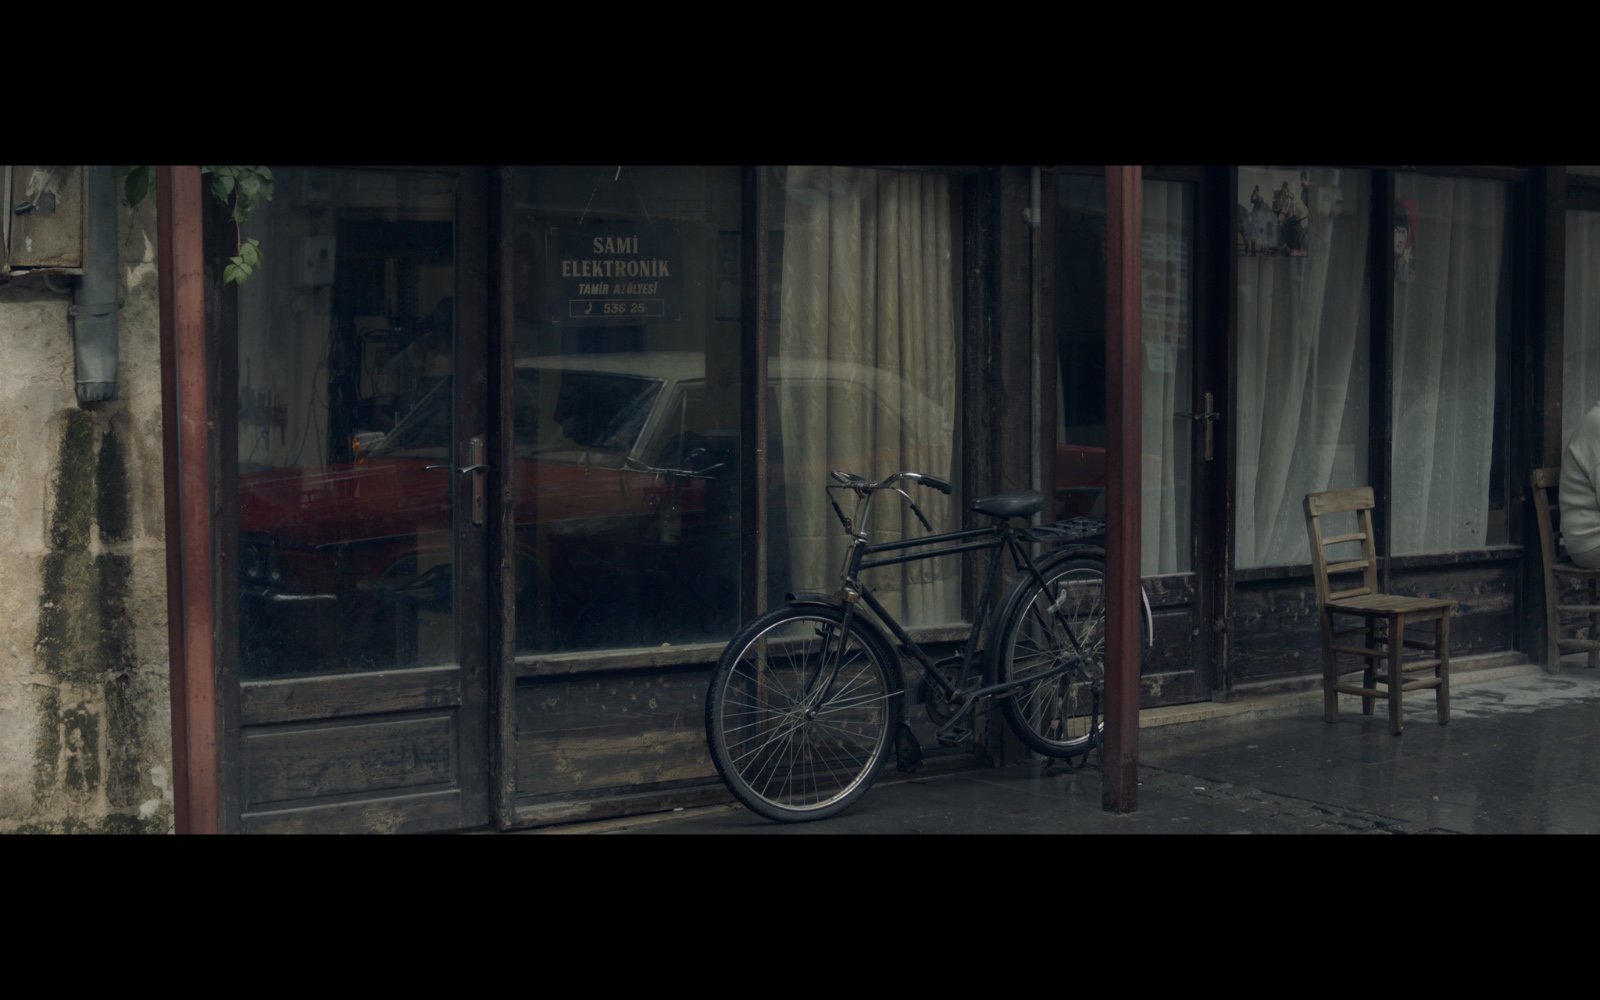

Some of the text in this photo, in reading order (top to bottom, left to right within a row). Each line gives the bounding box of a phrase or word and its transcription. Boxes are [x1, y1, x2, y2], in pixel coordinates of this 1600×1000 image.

[593, 235, 639, 254] SAMİ
[562, 258, 670, 277] ELEKTRONİK
[578, 281, 658, 295] TAMİR ATÖLYESİ
[603, 302, 645, 314] 536 25
